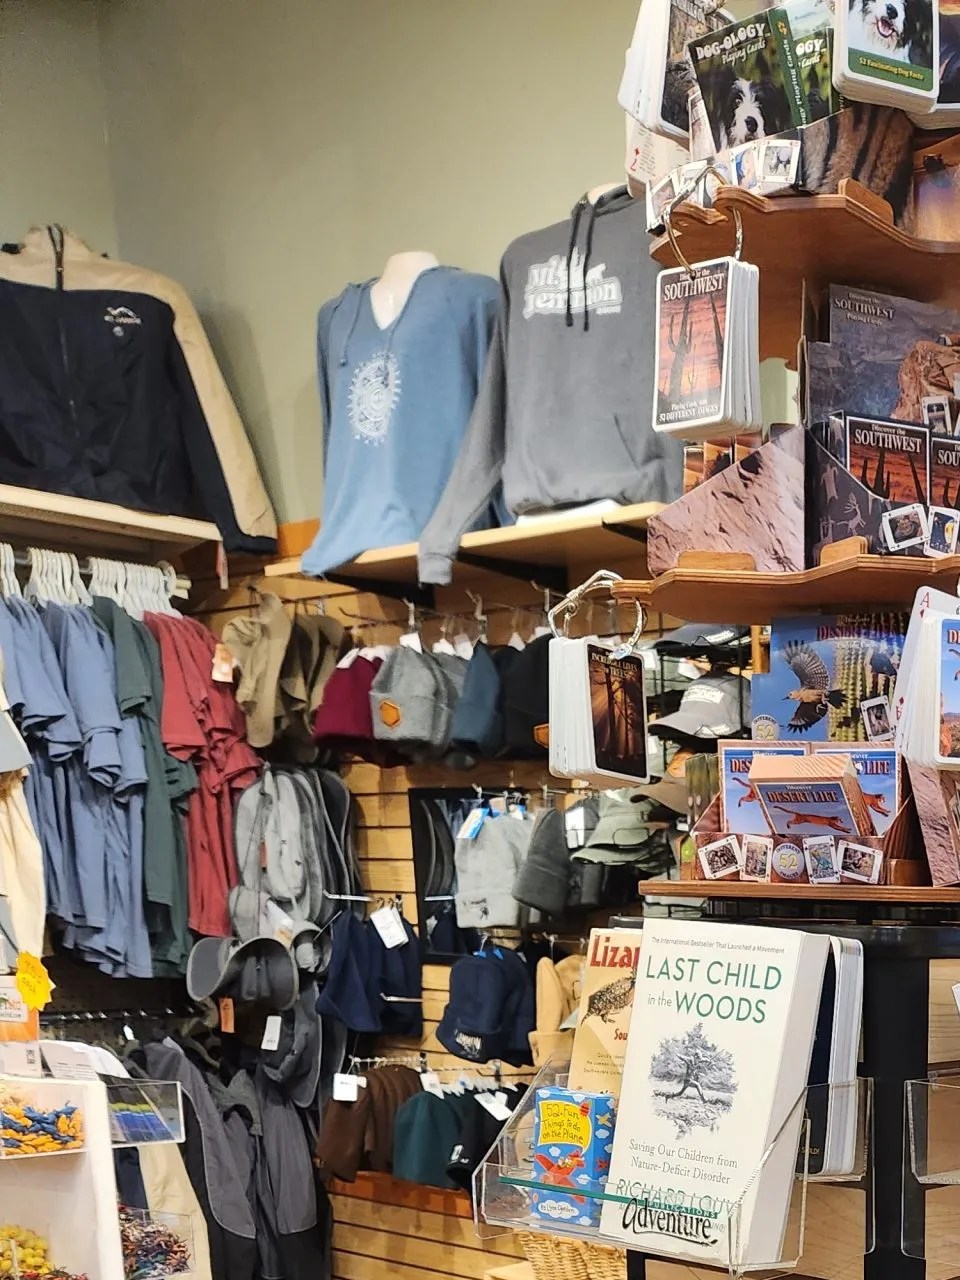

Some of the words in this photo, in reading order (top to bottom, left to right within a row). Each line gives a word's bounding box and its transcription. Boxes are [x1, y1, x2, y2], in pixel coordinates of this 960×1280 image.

[696, 23, 766, 60] DOG-OLOGY
[663, 272, 725, 301] SOUTHWEST
[834, 298, 896, 319] SOUTHWEST
[871, 423, 895, 434] Discover
[896, 427, 907, 436] the
[854, 430, 922, 453] SOUTHWEST
[755, 725, 774, 739] 52
[866, 760, 890, 775] LIFE
[767, 791, 810, 803] DESERT
[811, 790, 838, 803] LIFE
[779, 853, 798, 868] 52
[652, 936, 660, 945] The
[660, 937, 691, 948] International
[691, 940, 715, 949] Bestseller
[716, 941, 728, 950] That
[728, 943, 752, 952] Launched
[757, 944, 785, 954] Movement
[646, 955, 700, 983] LAST
[706, 960, 783, 991] CHILD
[647, 993, 656, 1006] in
[658, 990, 673, 1008] the
[675, 990, 767, 1024] WOODS
[563, 1104, 580, 1120] Fun
[541, 1119, 565, 1131] Things
[573, 1123, 581, 1133] do
[542, 1131, 551, 1140] on
[551, 1128, 561, 1139] the
[561, 1129, 584, 1146] Plane
[628, 1138, 656, 1157] Saving
[657, 1143, 676, 1158] Our
[677, 1147, 715, 1165] Children
[716, 1153, 739, 1169] from
[630, 1155, 691, 1178] Nature-Deficit
[692, 1167, 732, 1185] Disorder
[649, 1201, 718, 1219] PUBLICATIONS
